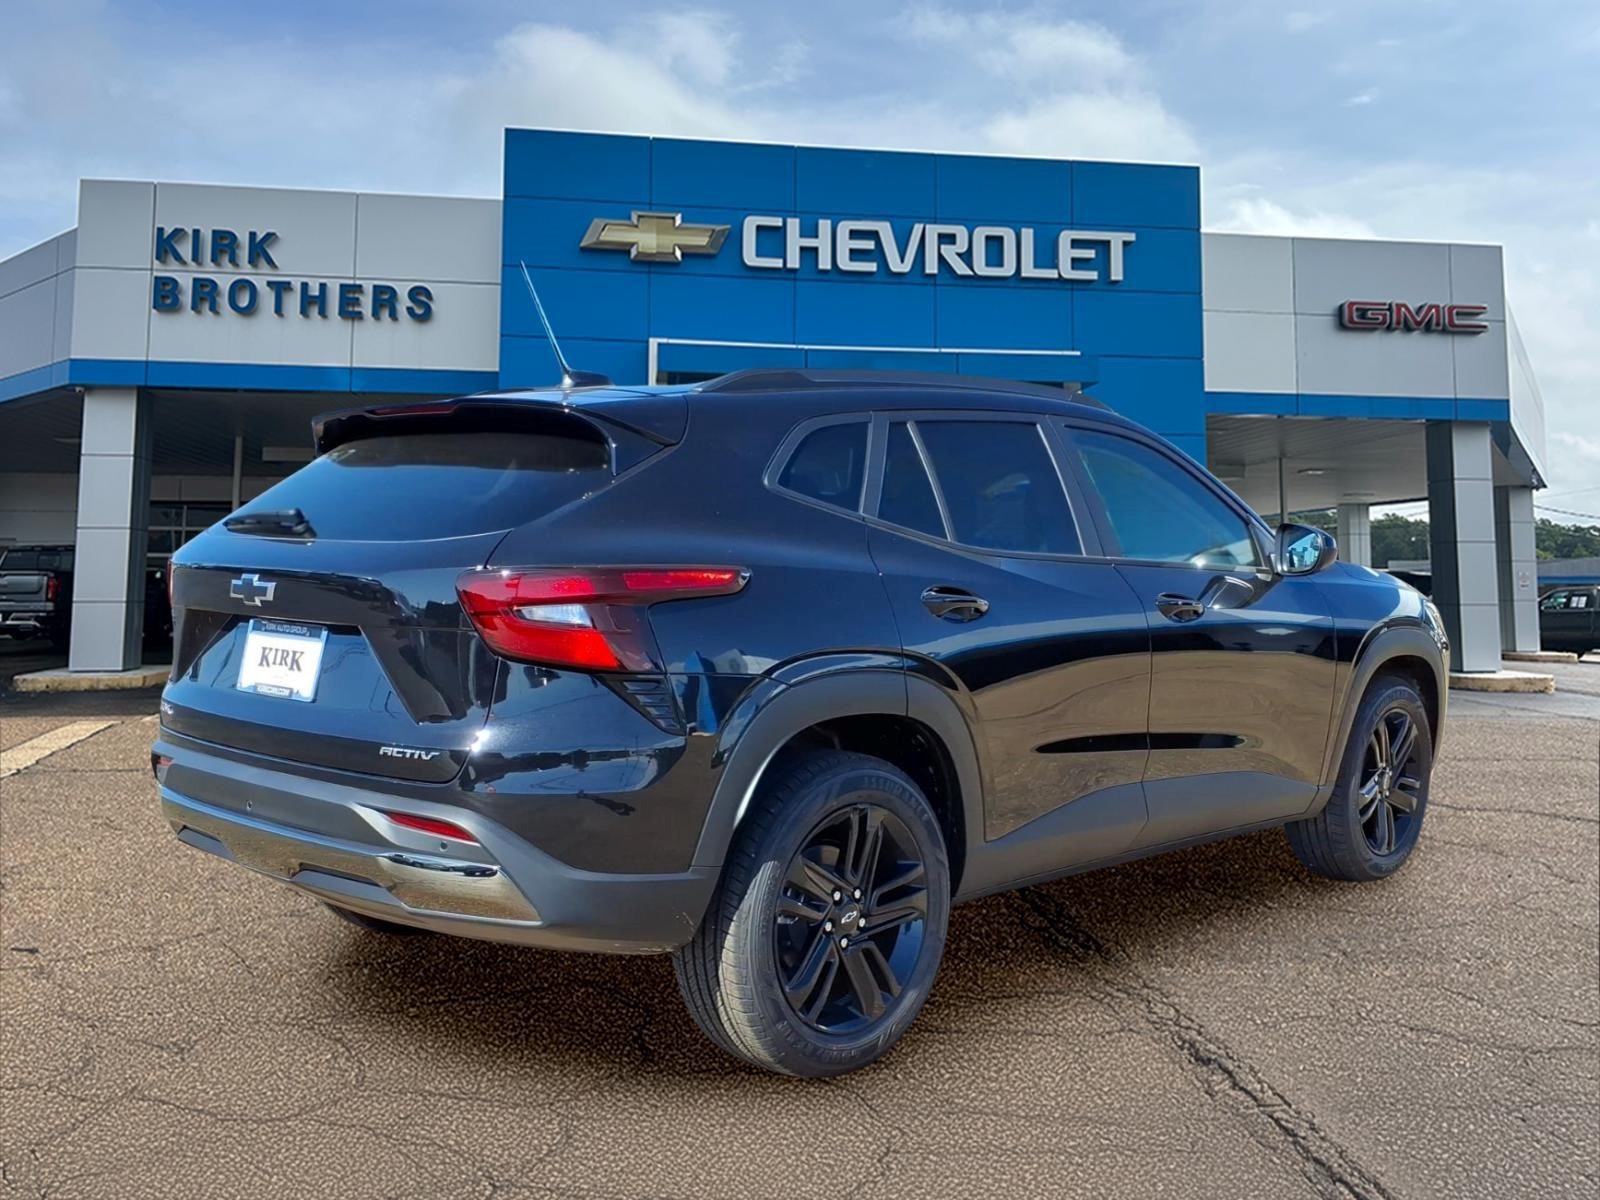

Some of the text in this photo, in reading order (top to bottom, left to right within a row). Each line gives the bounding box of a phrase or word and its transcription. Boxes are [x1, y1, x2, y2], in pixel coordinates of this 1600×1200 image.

[155, 226, 279, 270] KIRK
[742, 214, 1137, 282] CHEVROLET
[152, 275, 434, 323] BROTHERS
[1341, 299, 1489, 335] GMC
[258, 646, 305, 672] KIRK
[379, 746, 440, 760] ACTIV
